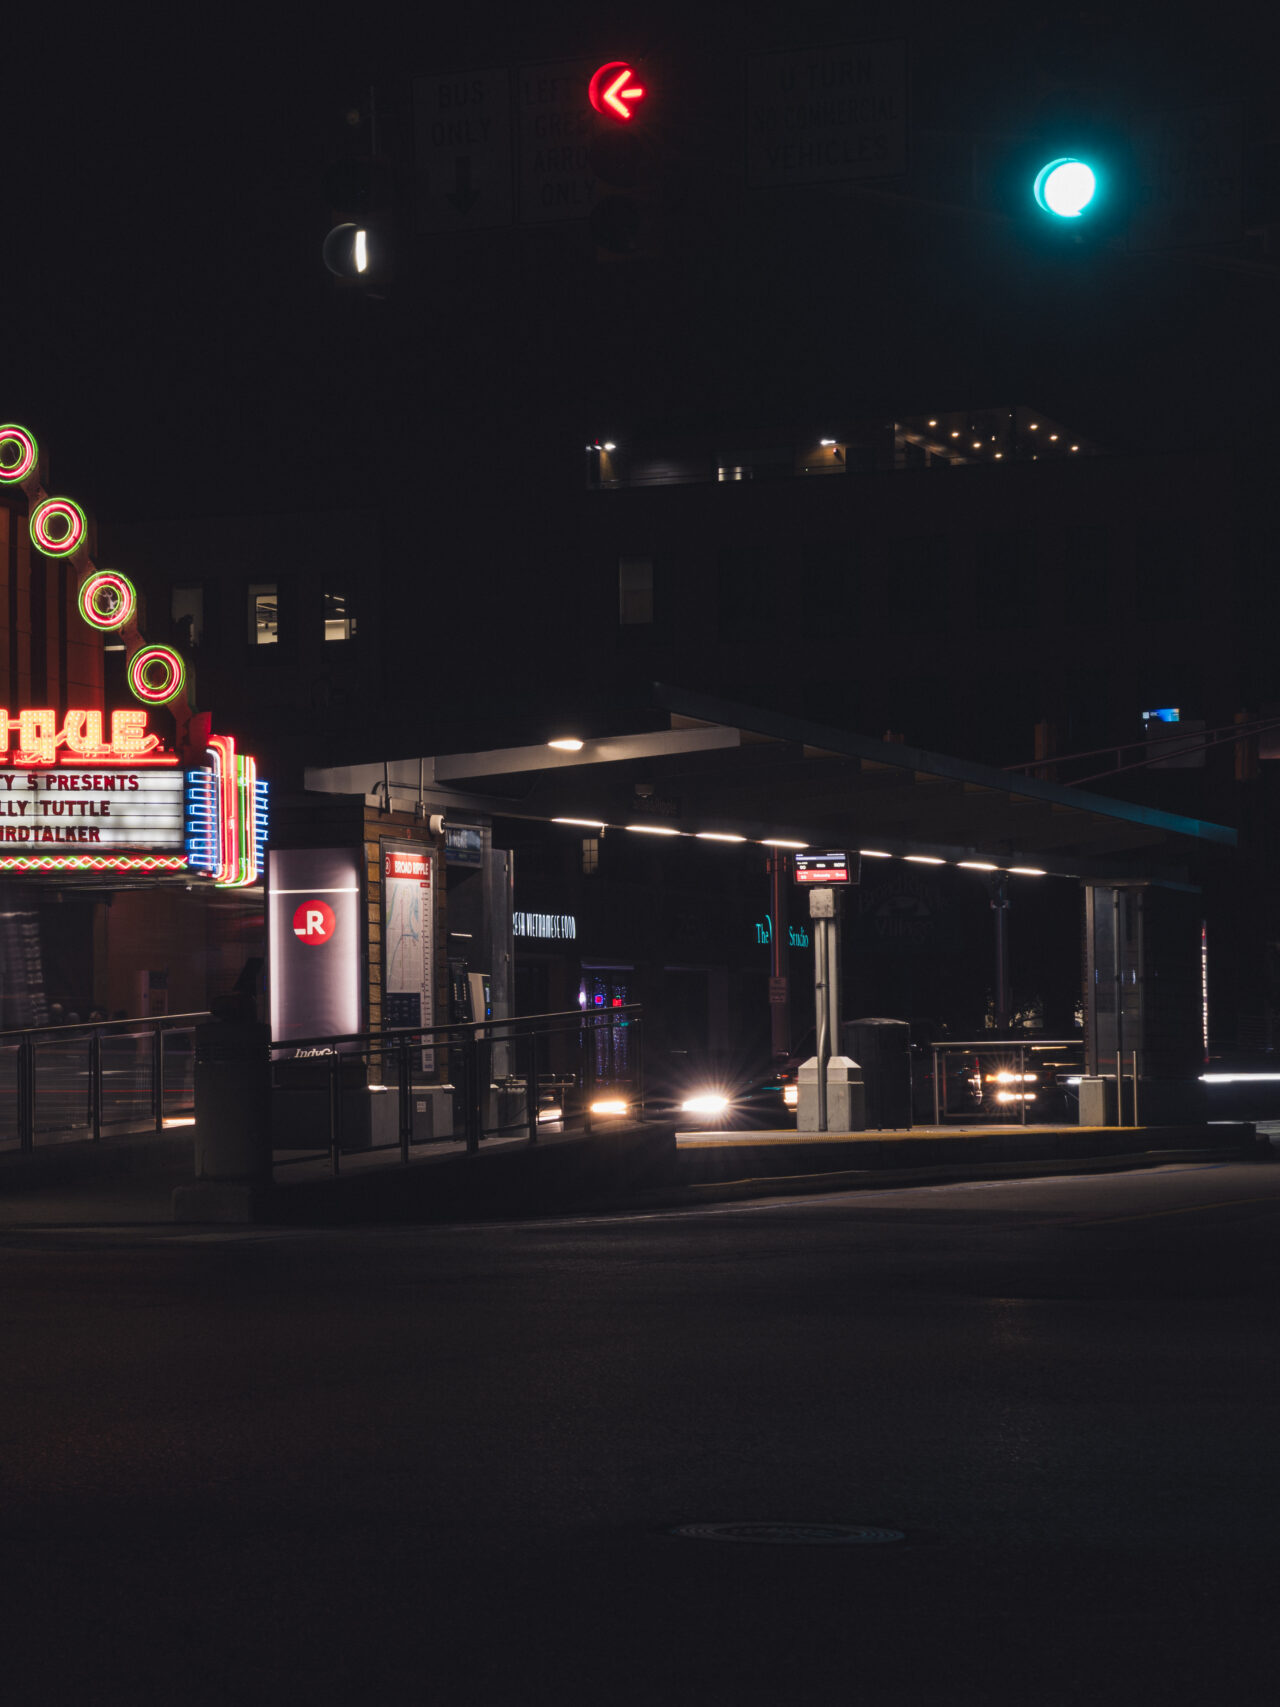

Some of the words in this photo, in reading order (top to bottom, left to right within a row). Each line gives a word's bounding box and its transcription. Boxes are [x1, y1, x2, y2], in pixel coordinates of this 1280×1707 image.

[437, 80, 484, 109] BUS
[430, 117, 492, 148] ONLY
[534, 109, 588, 139] GREE
[532, 145, 588, 174] ARRO
[767, 134, 888, 170] VEHICLES
[27, 774, 39, 791] 5
[45, 774, 140, 791] PRESENTS
[40, 800, 111, 817] TUTTLE
[394, 860, 412, 874] BROAD
[413, 862, 429, 876] RIPPLE
[561, 914, 576, 940] FOOD
[755, 923, 769, 944] The
